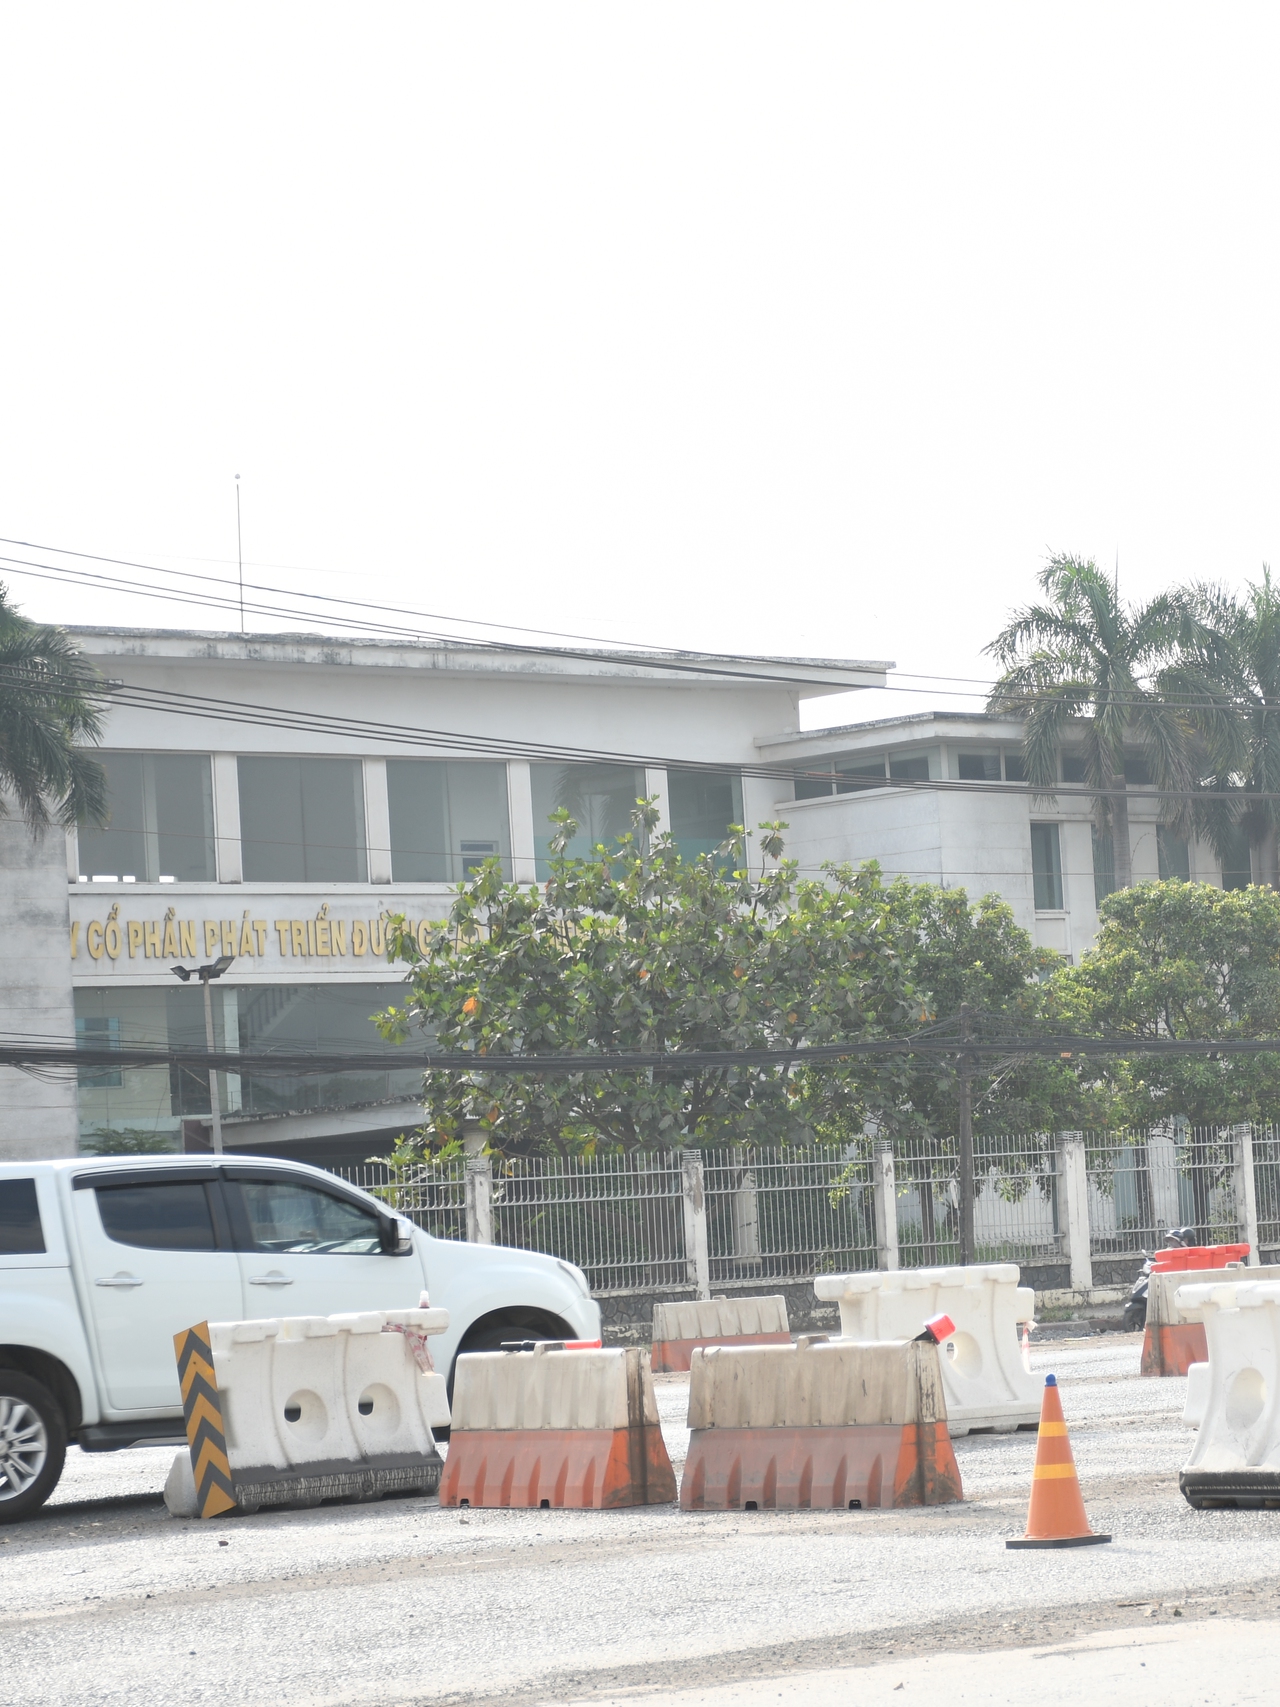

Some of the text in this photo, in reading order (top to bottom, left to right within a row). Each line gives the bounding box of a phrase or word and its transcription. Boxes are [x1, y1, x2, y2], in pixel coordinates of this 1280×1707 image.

[87, 902, 122, 960] CỔ
[127, 907, 197, 958] PHẦN
[203, 910, 267, 957] PHÁT
[275, 903, 346, 957] TRIỂN
[352, 909, 432, 957] ĐƯG
